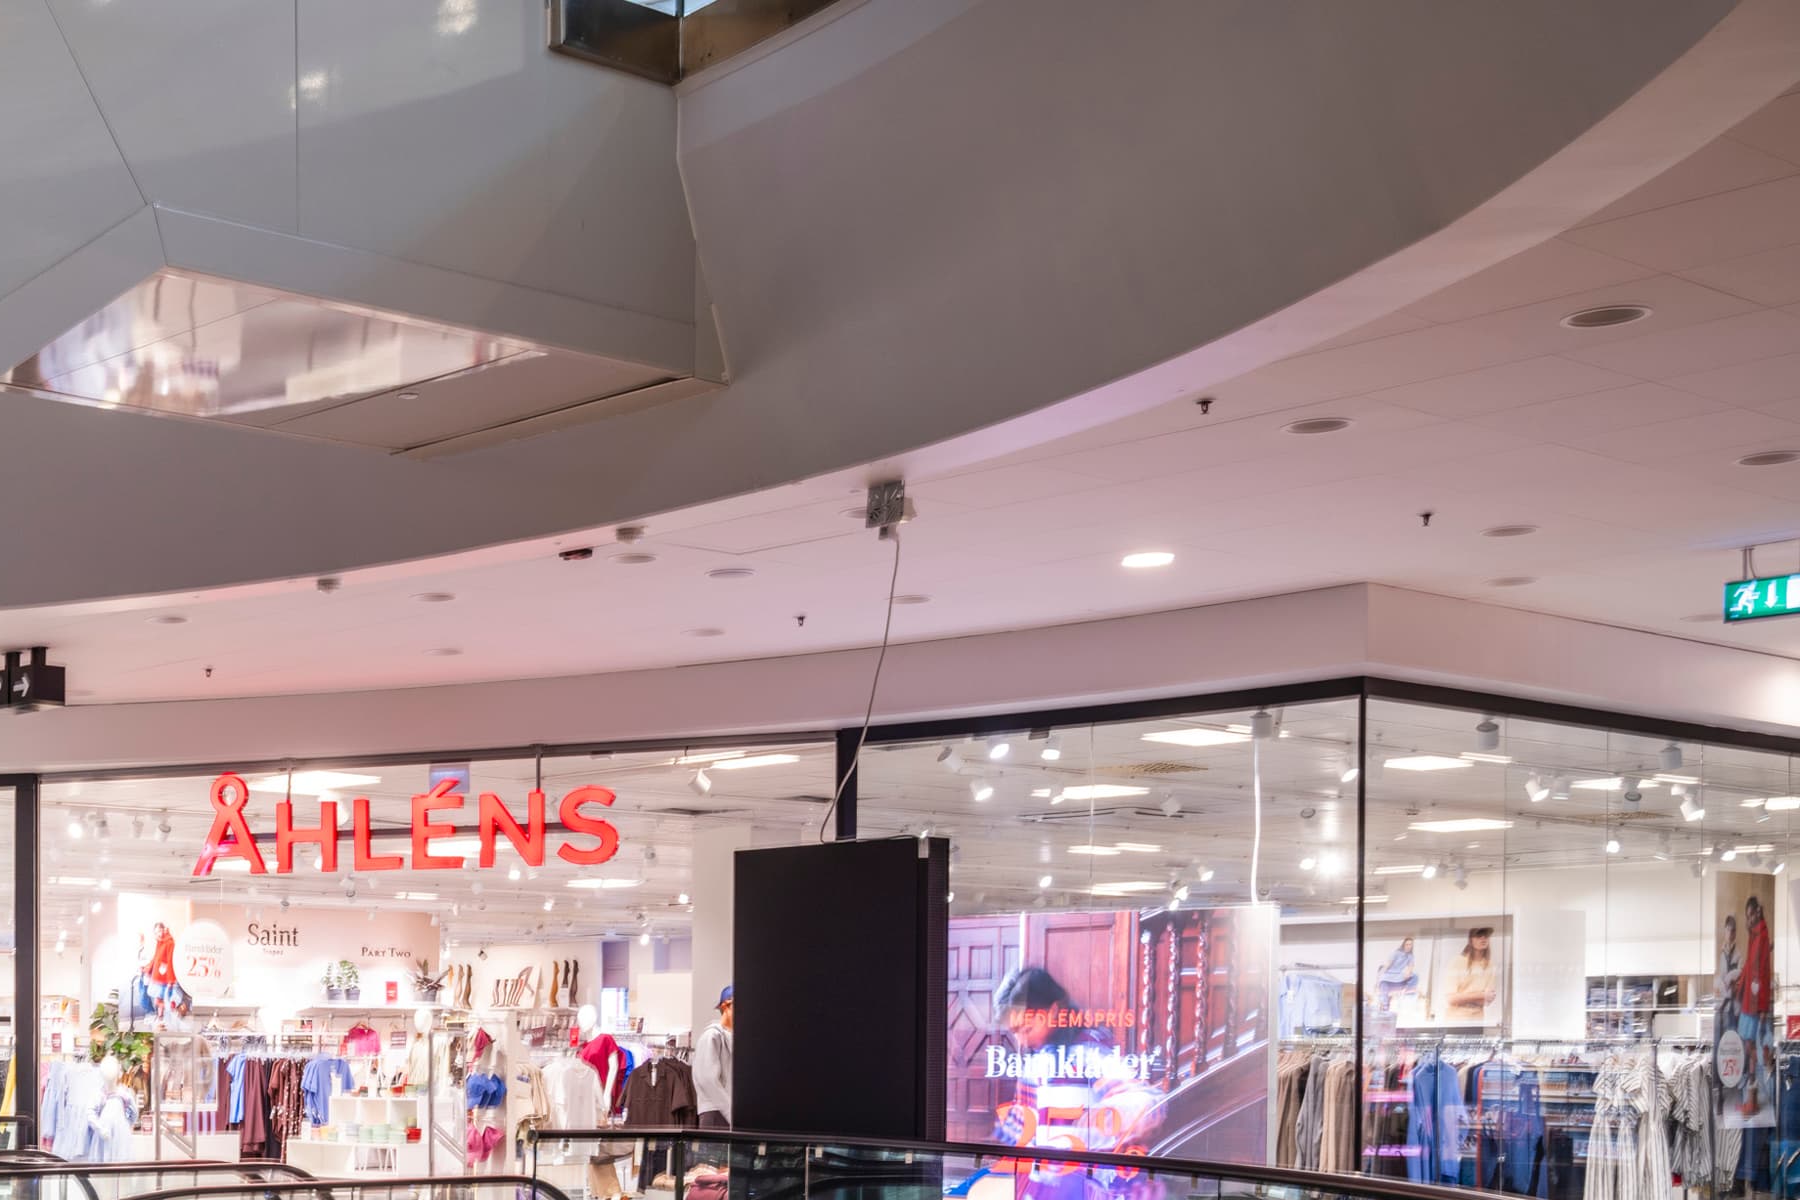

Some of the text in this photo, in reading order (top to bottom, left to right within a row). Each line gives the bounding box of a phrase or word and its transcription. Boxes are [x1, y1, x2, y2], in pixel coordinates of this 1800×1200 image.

[192, 771, 620, 876] ÅHLÉNS
[247, 922, 299, 948] Saint
[186, 955, 221, 978] 25%
[1009, 1008, 1137, 1028] MEDLEMSPRIS
